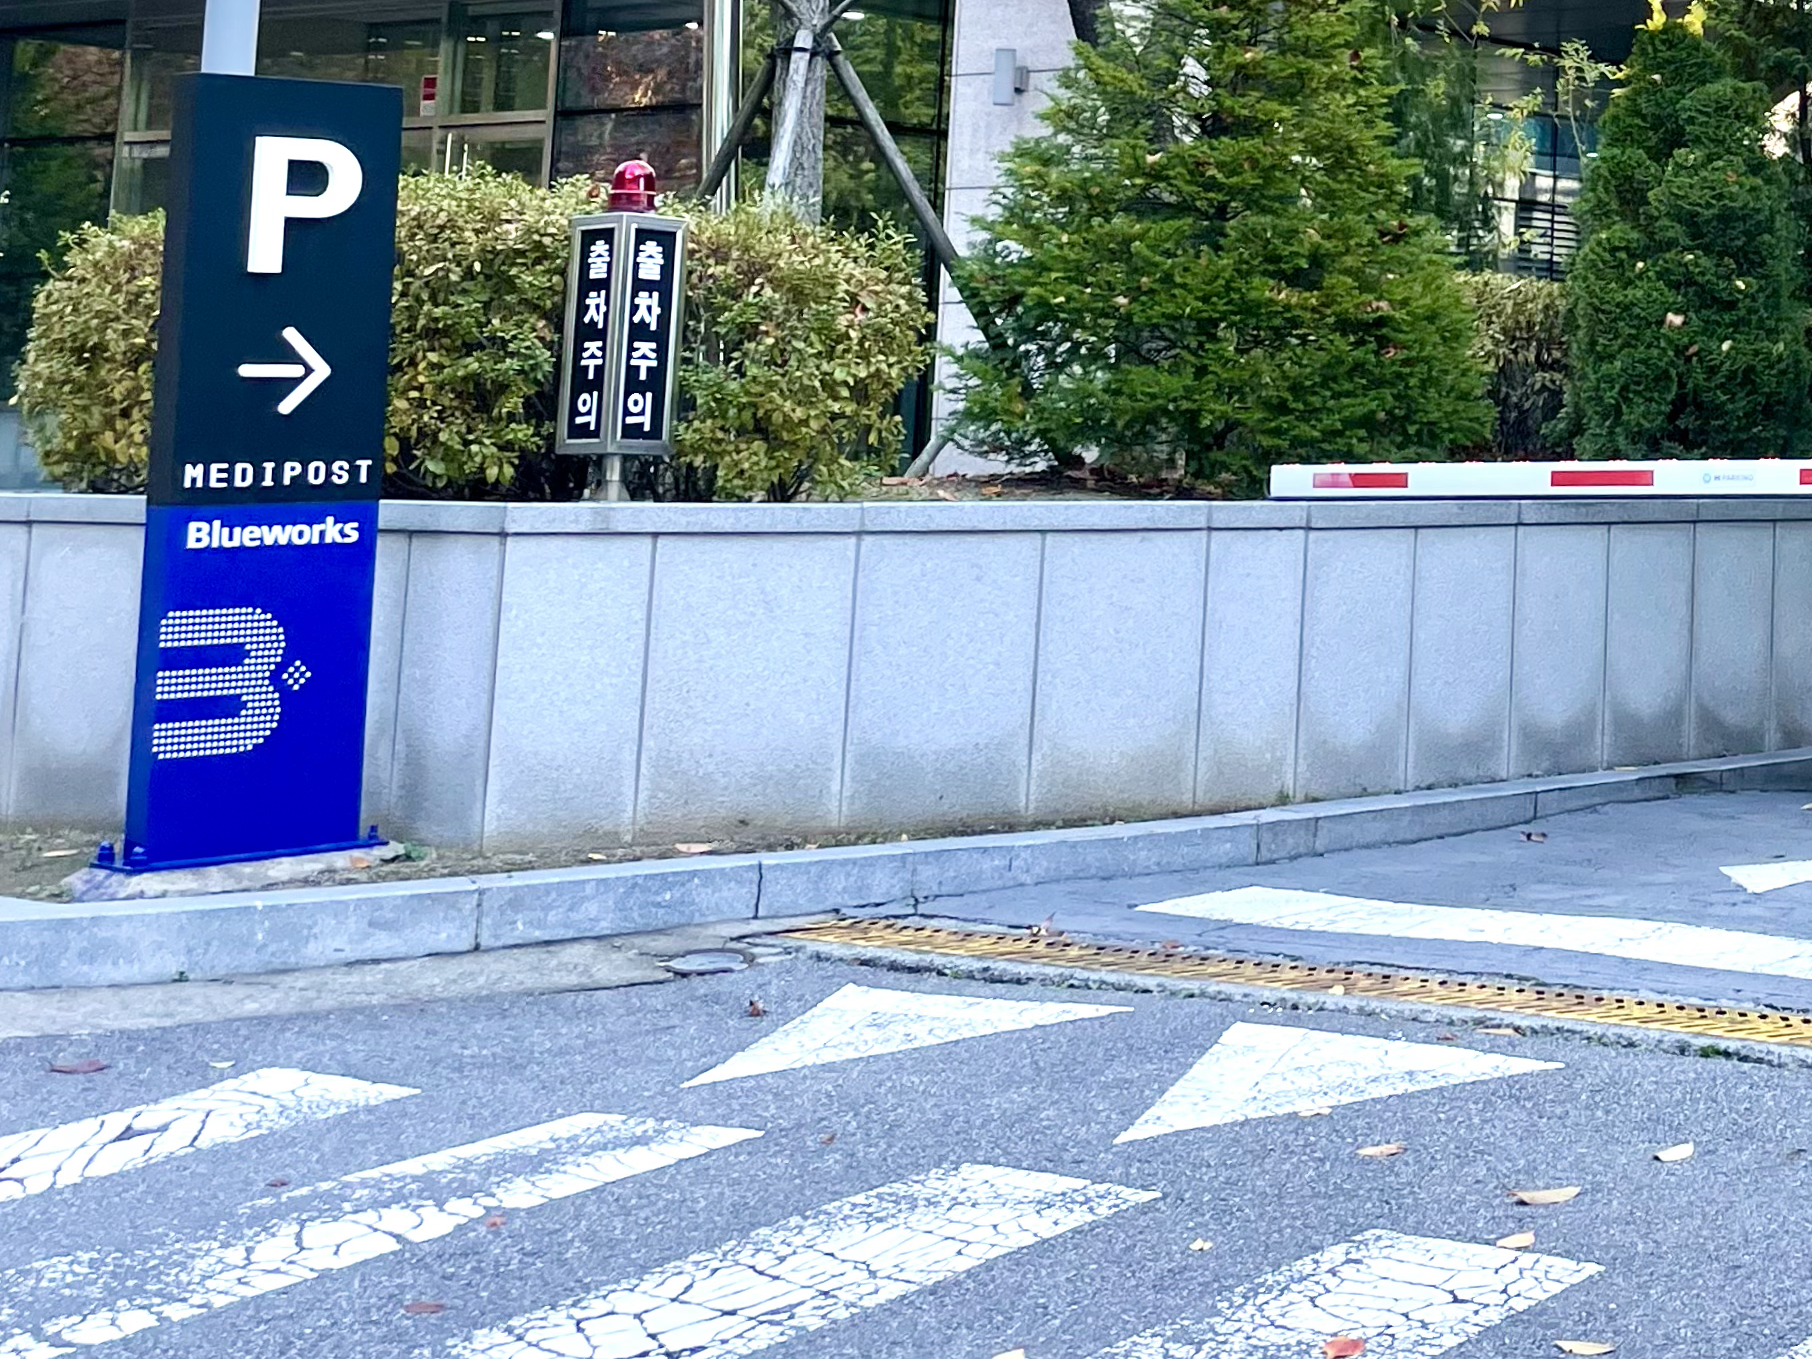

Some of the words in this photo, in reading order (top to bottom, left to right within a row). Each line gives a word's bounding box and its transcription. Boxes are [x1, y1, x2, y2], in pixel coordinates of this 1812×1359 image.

[246, 135, 363, 274] P
[574, 239, 611, 431] 출차주의
[624, 240, 665, 432] 출차주의
[182, 458, 374, 489] MEDIPOST
[185, 515, 360, 550] Blueworks
